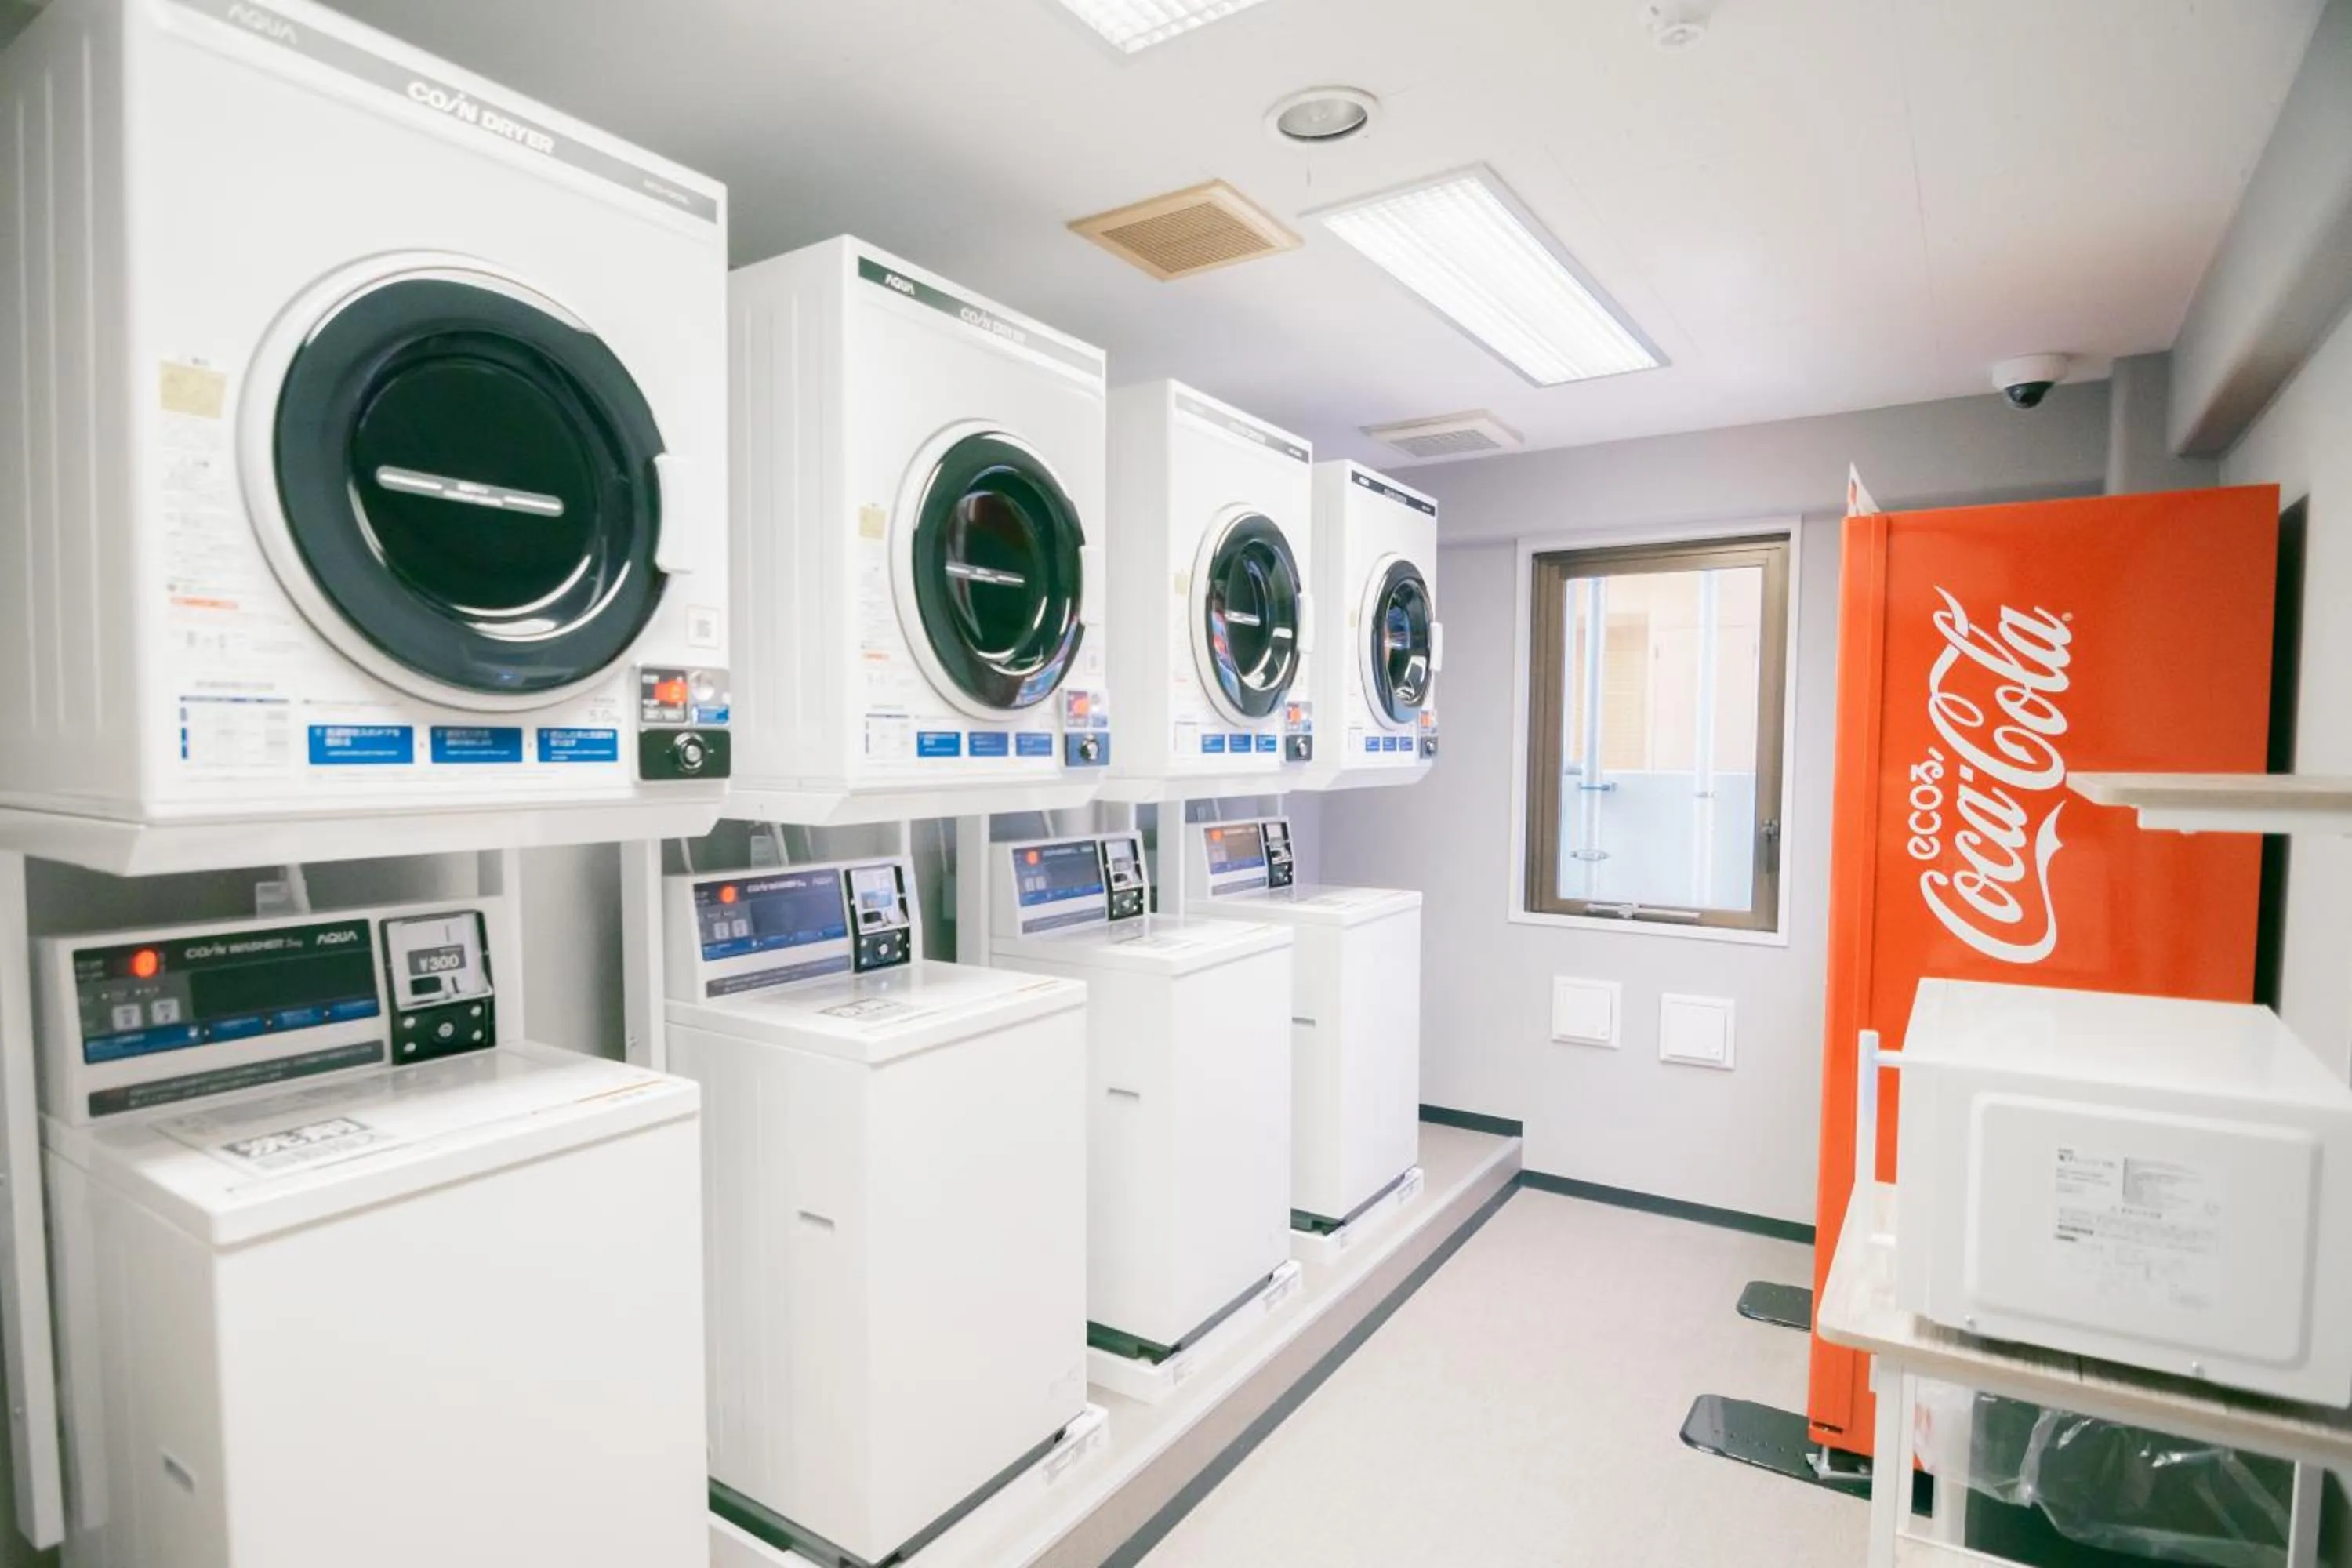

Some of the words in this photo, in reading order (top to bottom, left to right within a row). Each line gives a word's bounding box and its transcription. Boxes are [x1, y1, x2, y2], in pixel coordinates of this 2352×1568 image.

[227, 4, 297, 45] AQUA
[481, 109, 554, 154] DRYER
[885, 274, 915, 296] AQUA
[316, 930, 358, 946] AQUA
